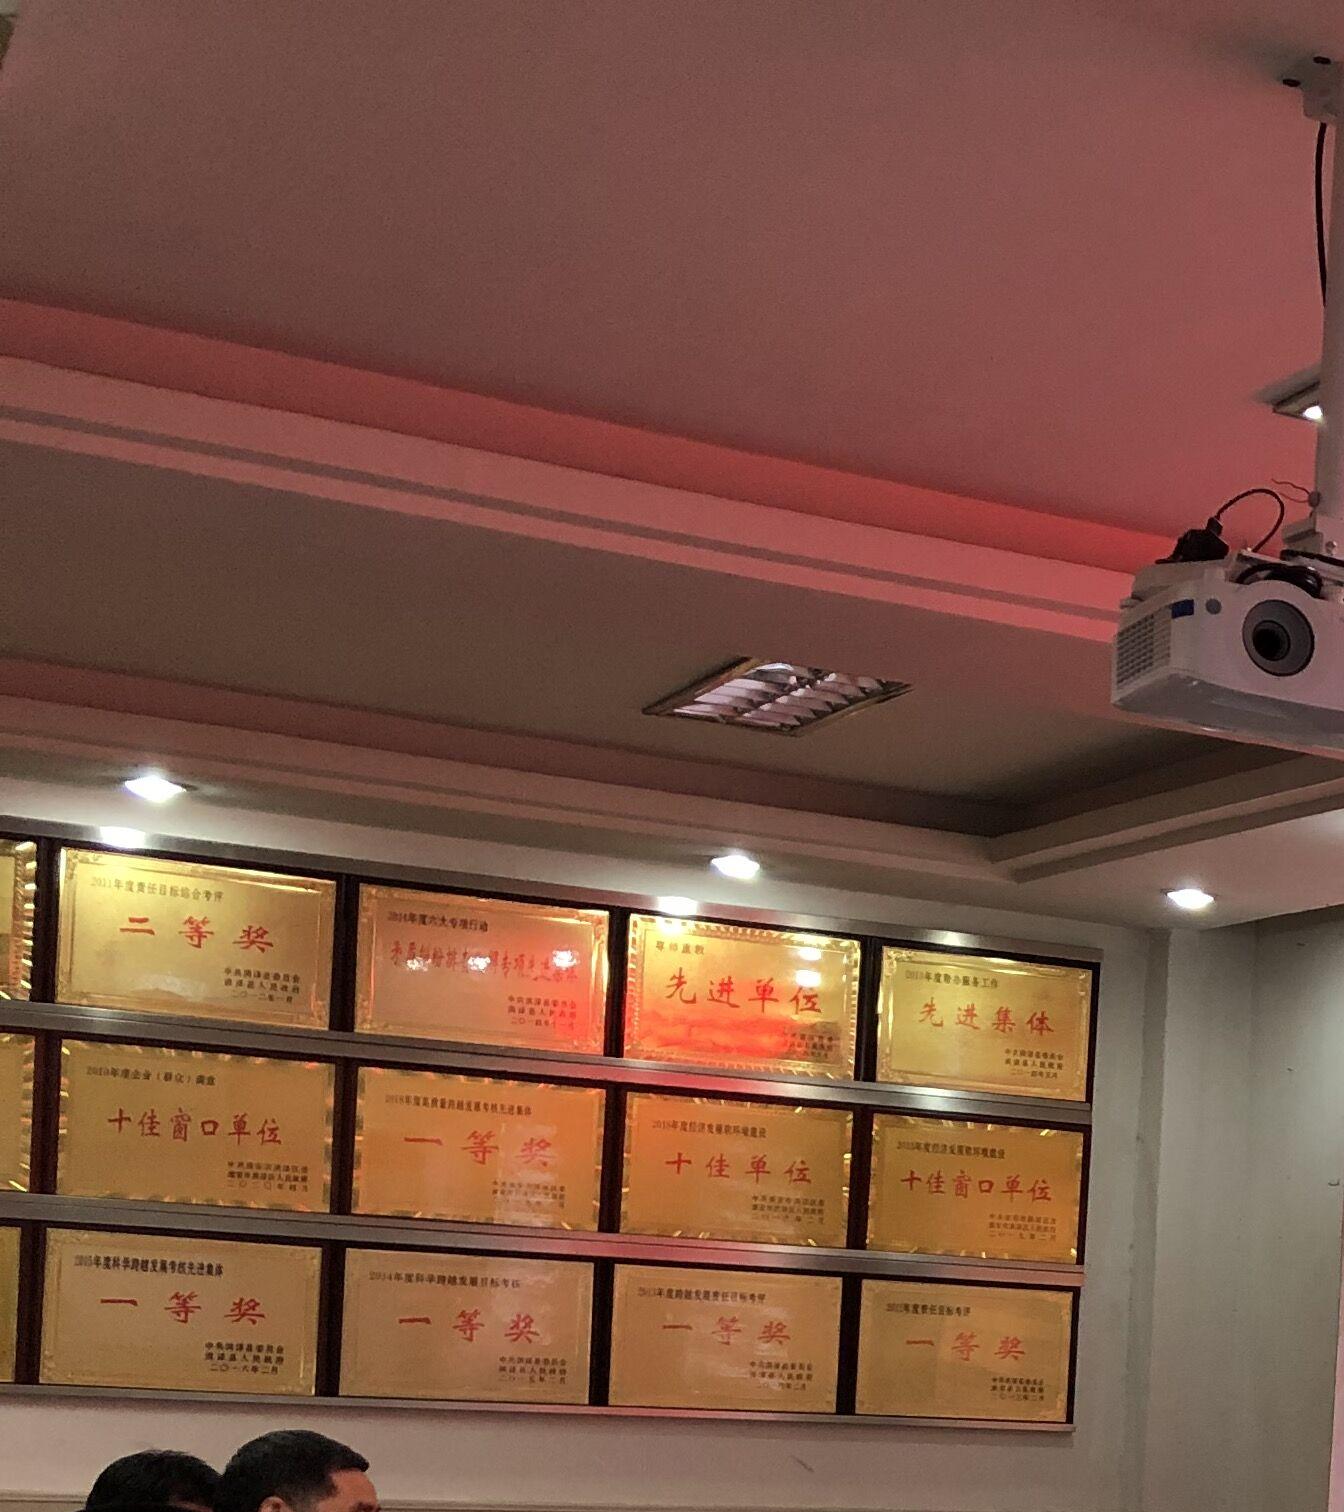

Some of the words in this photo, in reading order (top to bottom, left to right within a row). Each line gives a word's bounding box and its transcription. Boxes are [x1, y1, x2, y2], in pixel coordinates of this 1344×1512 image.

[120, 916, 273, 953] 二等奖
[666, 967, 821, 1014] 先进单位
[919, 997, 1054, 1036] 先进集体
[107, 1107, 282, 1146] 十佳窗口单位
[404, 1130, 556, 1166] 一等奖
[666, 1152, 811, 1184] 十佳单位
[901, 1170, 1052, 1203] 十佳窗口单位
[100, 1291, 265, 1325] 一等奖
[398, 1309, 540, 1344] 一等奖
[662, 1316, 791, 1346] 一等奖
[906, 1332, 1025, 1362] 一等奖
